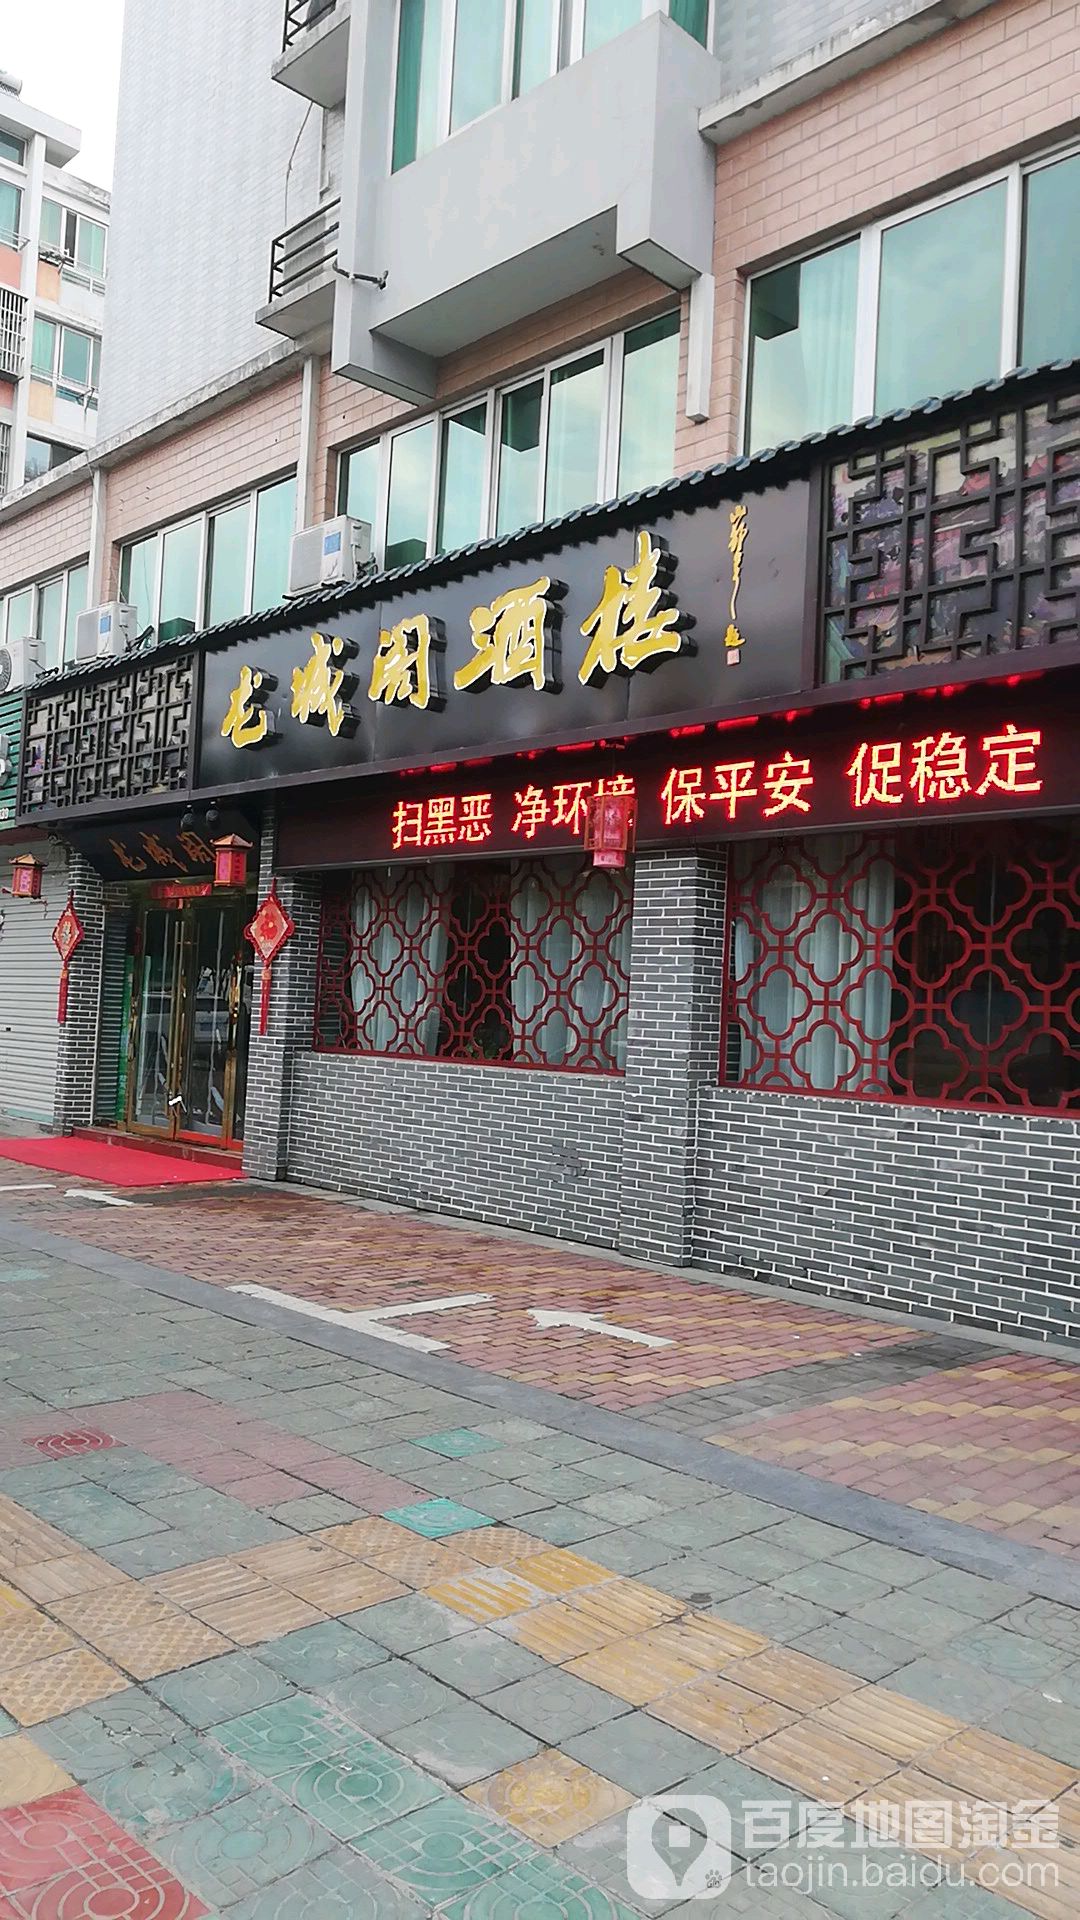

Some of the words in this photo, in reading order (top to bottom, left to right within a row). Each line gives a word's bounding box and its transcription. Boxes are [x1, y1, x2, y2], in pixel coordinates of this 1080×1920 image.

[220, 530, 683, 748] 龙城阁酒楼
[391, 793, 493, 850] 扫黑恶
[660, 751, 815, 826] 保平安
[846, 724, 1045, 808] 促稳定
